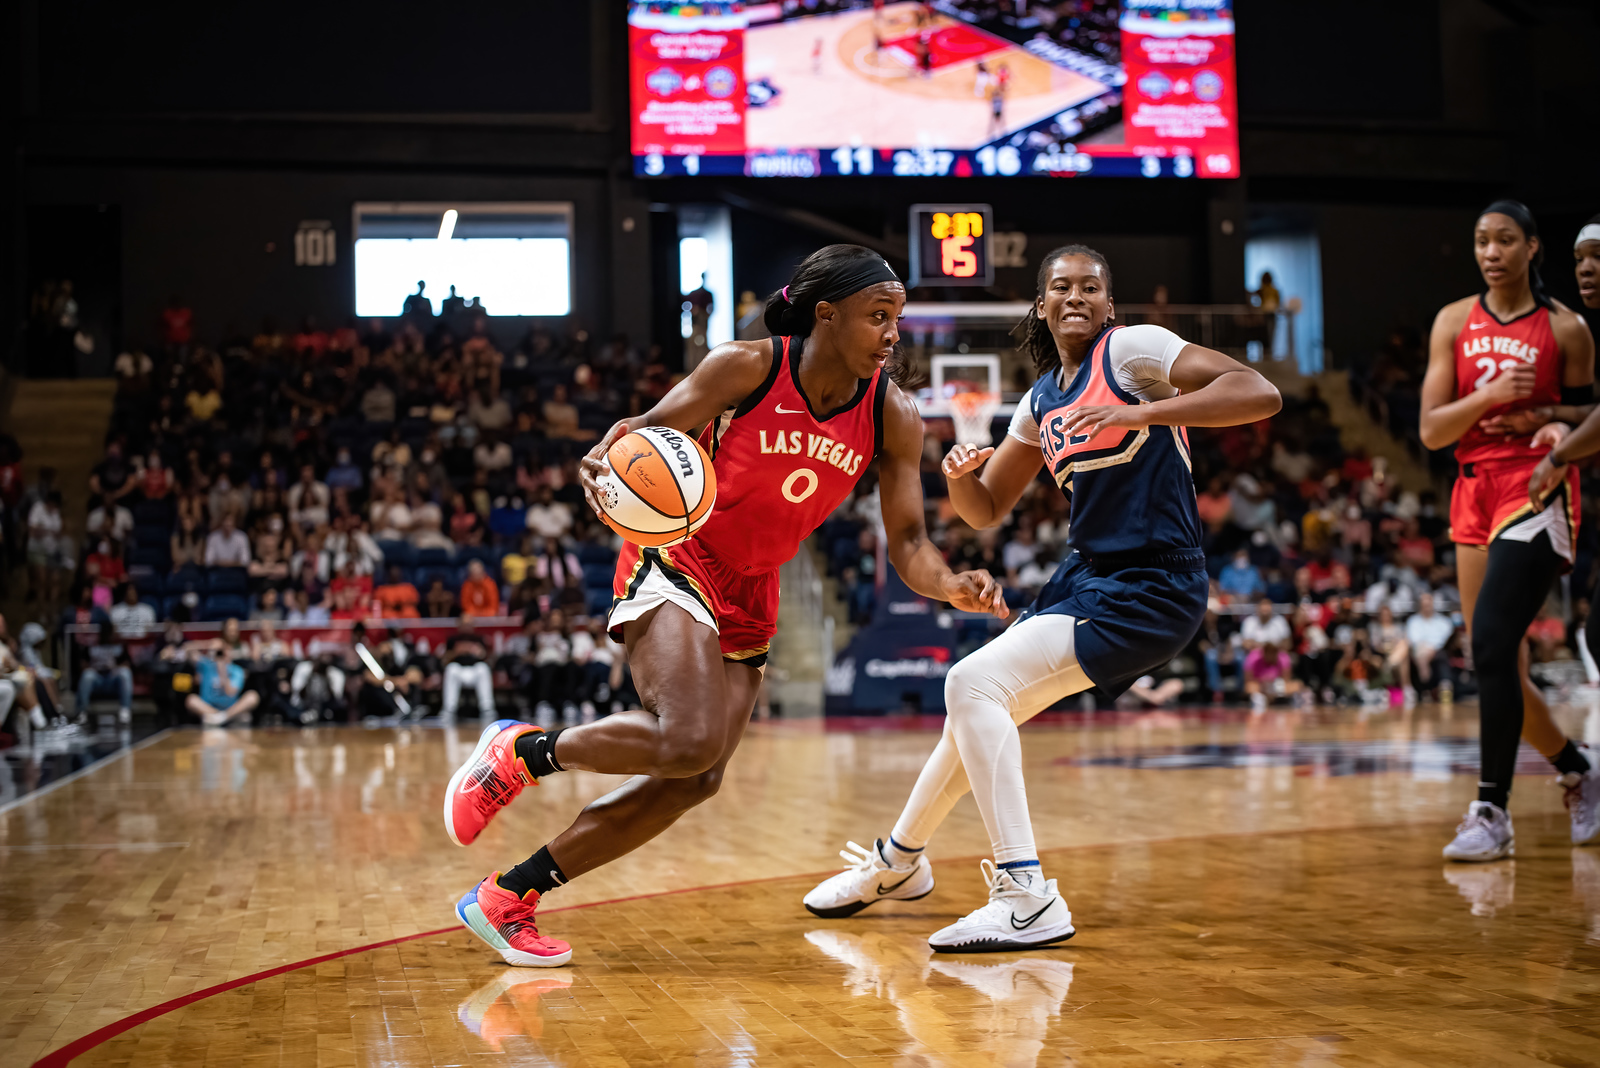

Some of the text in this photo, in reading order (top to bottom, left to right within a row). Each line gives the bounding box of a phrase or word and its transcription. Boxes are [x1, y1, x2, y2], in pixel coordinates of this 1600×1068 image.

[644, 153, 665, 176] 3
[682, 154, 700, 176] 1
[832, 146, 874, 175] 11
[893, 150, 954, 176] 2:37
[976, 146, 1021, 176] 16
[1141, 155, 1161, 178] 3
[1173, 155, 1193, 178] 3
[294, 229, 336, 266] 101
[941, 235, 977, 277] 15
[1463, 336, 1539, 364] LAS VEGAS
[646, 427, 694, 478] Wilson
[759, 430, 863, 476] LAS VEGAS
[781, 468, 818, 503] 0
